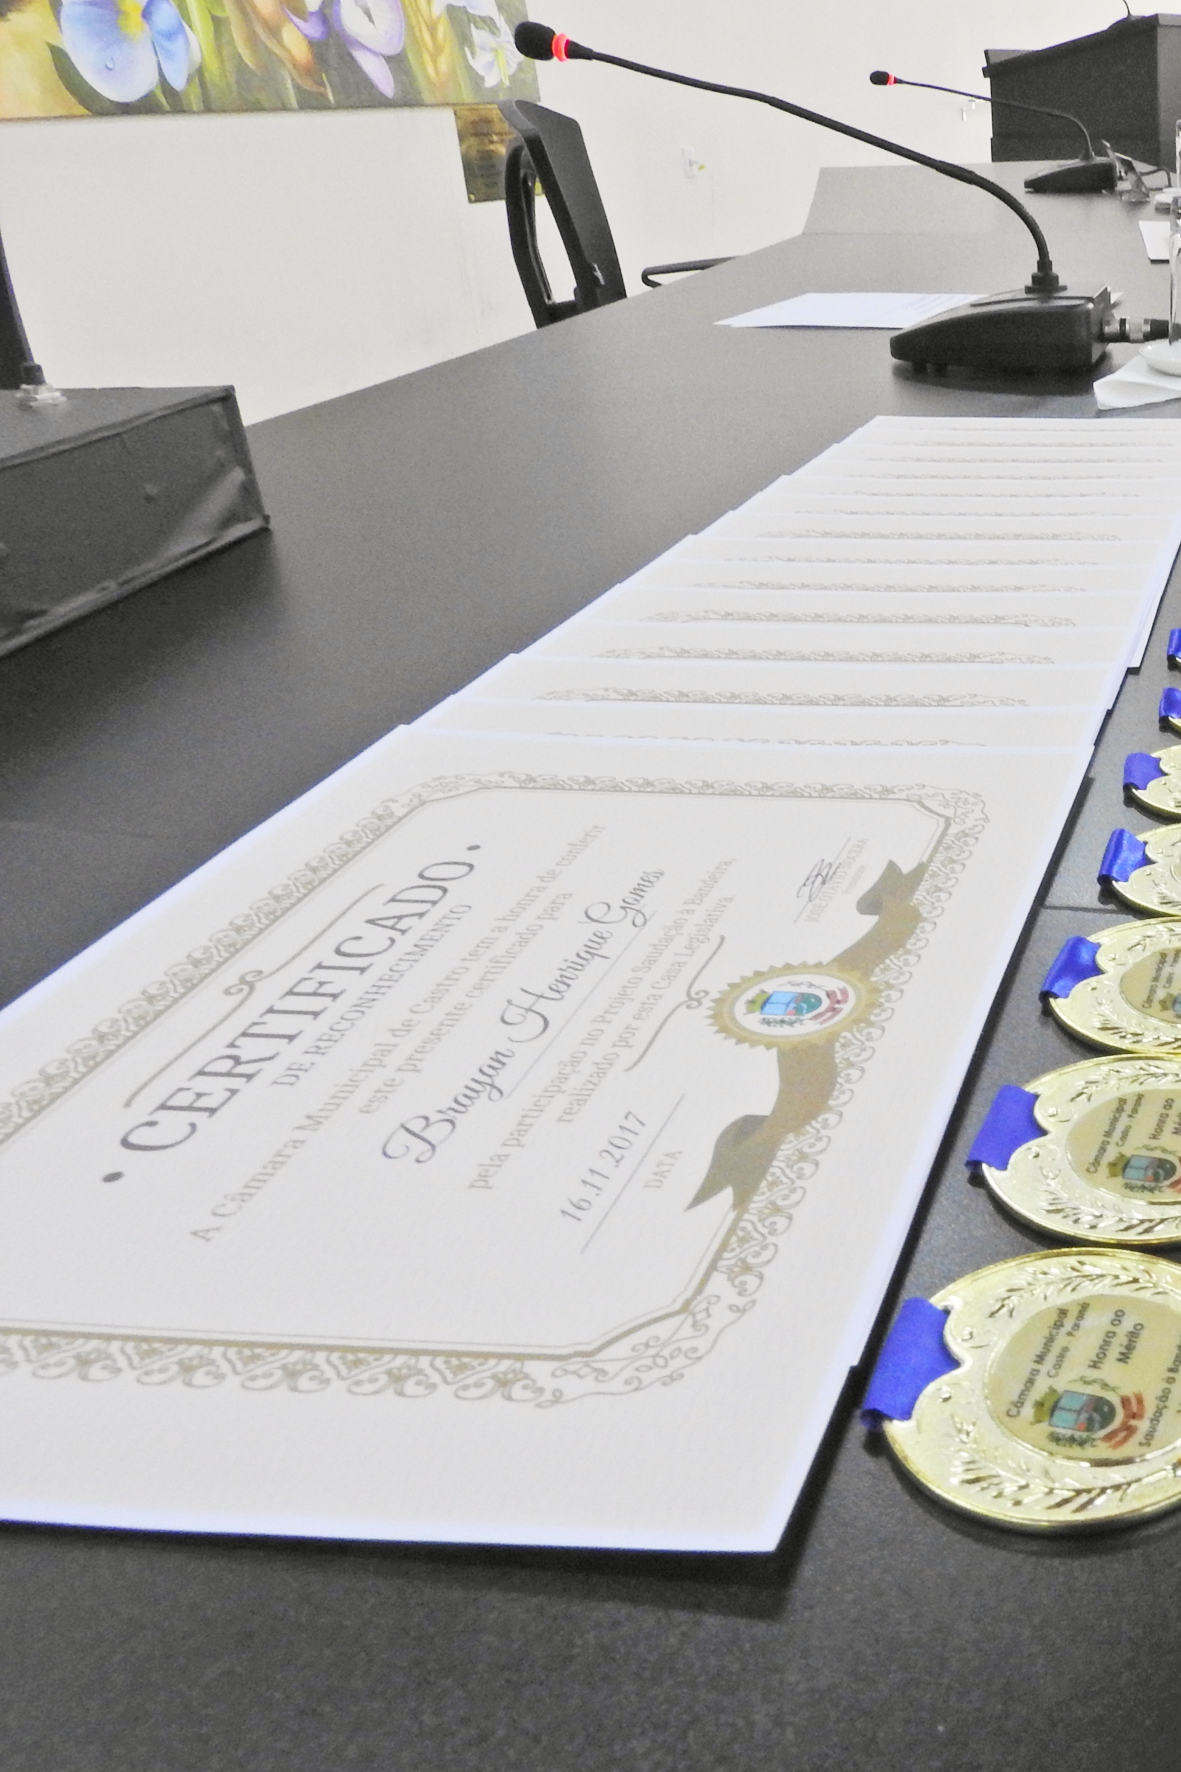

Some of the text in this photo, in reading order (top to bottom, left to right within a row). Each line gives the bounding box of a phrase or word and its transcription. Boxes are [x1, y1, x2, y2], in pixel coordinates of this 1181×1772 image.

[631, 917, 688, 973] Saudação
[120, 861, 474, 1151] CERTIFICADO
[270, 904, 472, 1086] DE RECONHECIMENTO
[358, 892, 574, 1114] este presente certificado para
[382, 867, 665, 1164] Brayan Henrique Gomes
[592, 976, 643, 1026] Projeto
[190, 824, 606, 1242] A Câmara Municipal de Castro tem a honra de conferir
[555, 1051, 620, 1123] realizado
[611, 1020, 641, 1048] por
[632, 992, 663, 1020] esta
[650, 960, 688, 990] Casa
[580, 1028, 605, 1047] no
[501, 1050, 587, 1148] participação
[1149, 1098, 1175, 1140] Honra ao
[468, 1152, 510, 1190] pela
[560, 1111, 646, 1222] 16.11.2017
[642, 1150, 683, 1190] DATA
[1006, 1307, 1069, 1418] Câmara Municipal
[1047, 1346, 1071, 1378] Castro
[1088, 1309, 1126, 1370] Honra ao
[1116, 1323, 1145, 1365] Mérito
[1138, 1387, 1173, 1448] Saudação
